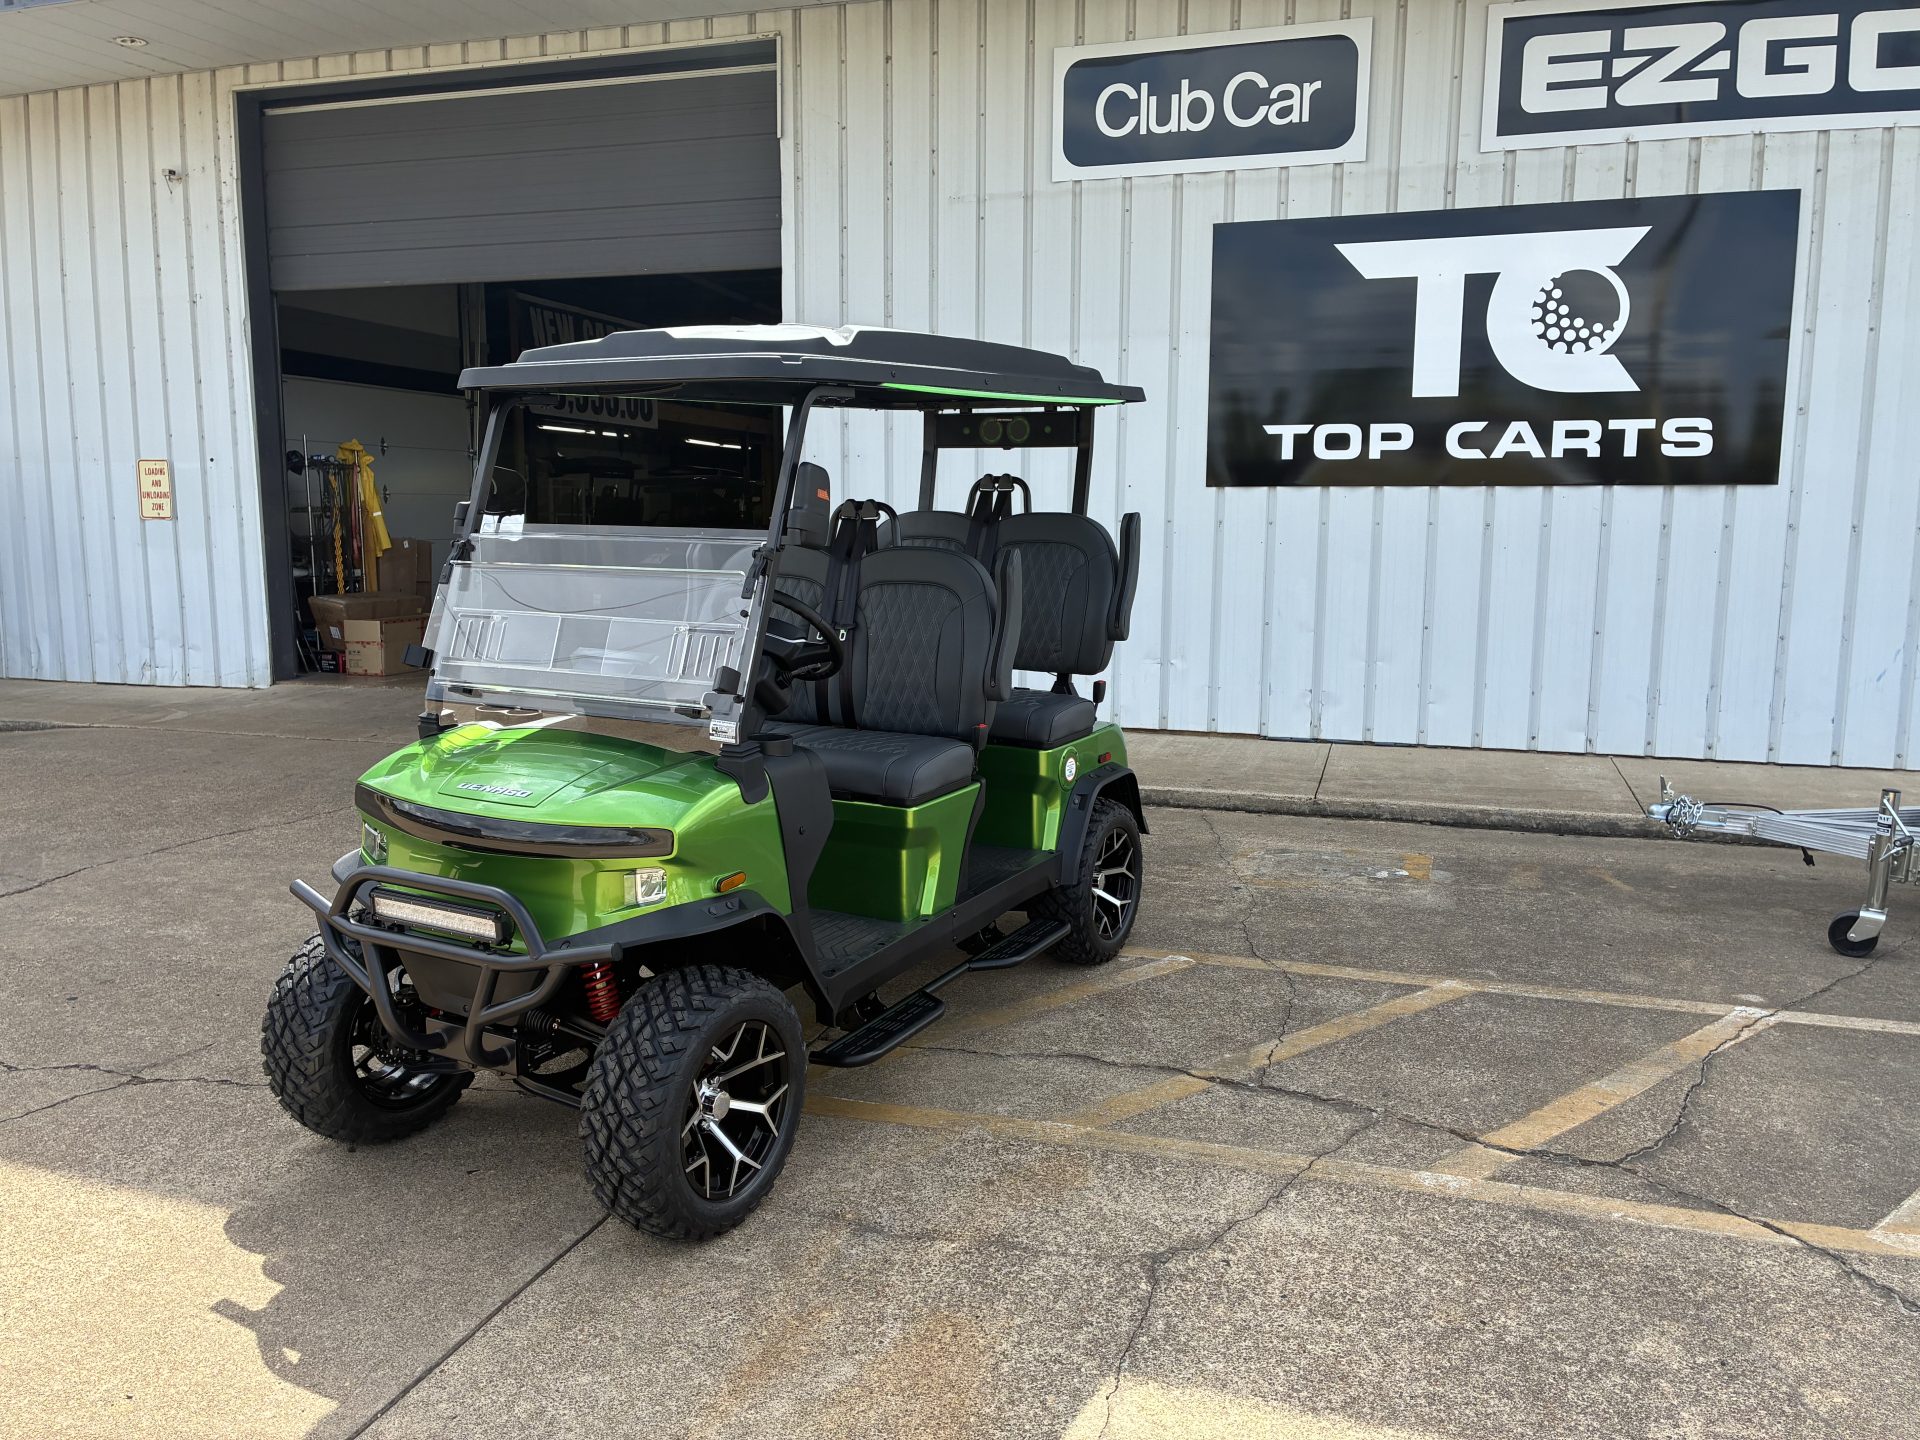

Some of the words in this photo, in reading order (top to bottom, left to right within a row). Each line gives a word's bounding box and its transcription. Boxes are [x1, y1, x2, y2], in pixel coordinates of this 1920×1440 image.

[1095, 78, 1215, 138] Club
[1223, 71, 1322, 128] Car
[1262, 423, 1415, 461] TOP
[1445, 417, 1714, 460] CARTS
[144, 467, 166, 476] LOADING
[151, 479, 162, 488] AND
[142, 491, 170, 500] UNLOADING
[151, 502, 165, 511] ZONE
